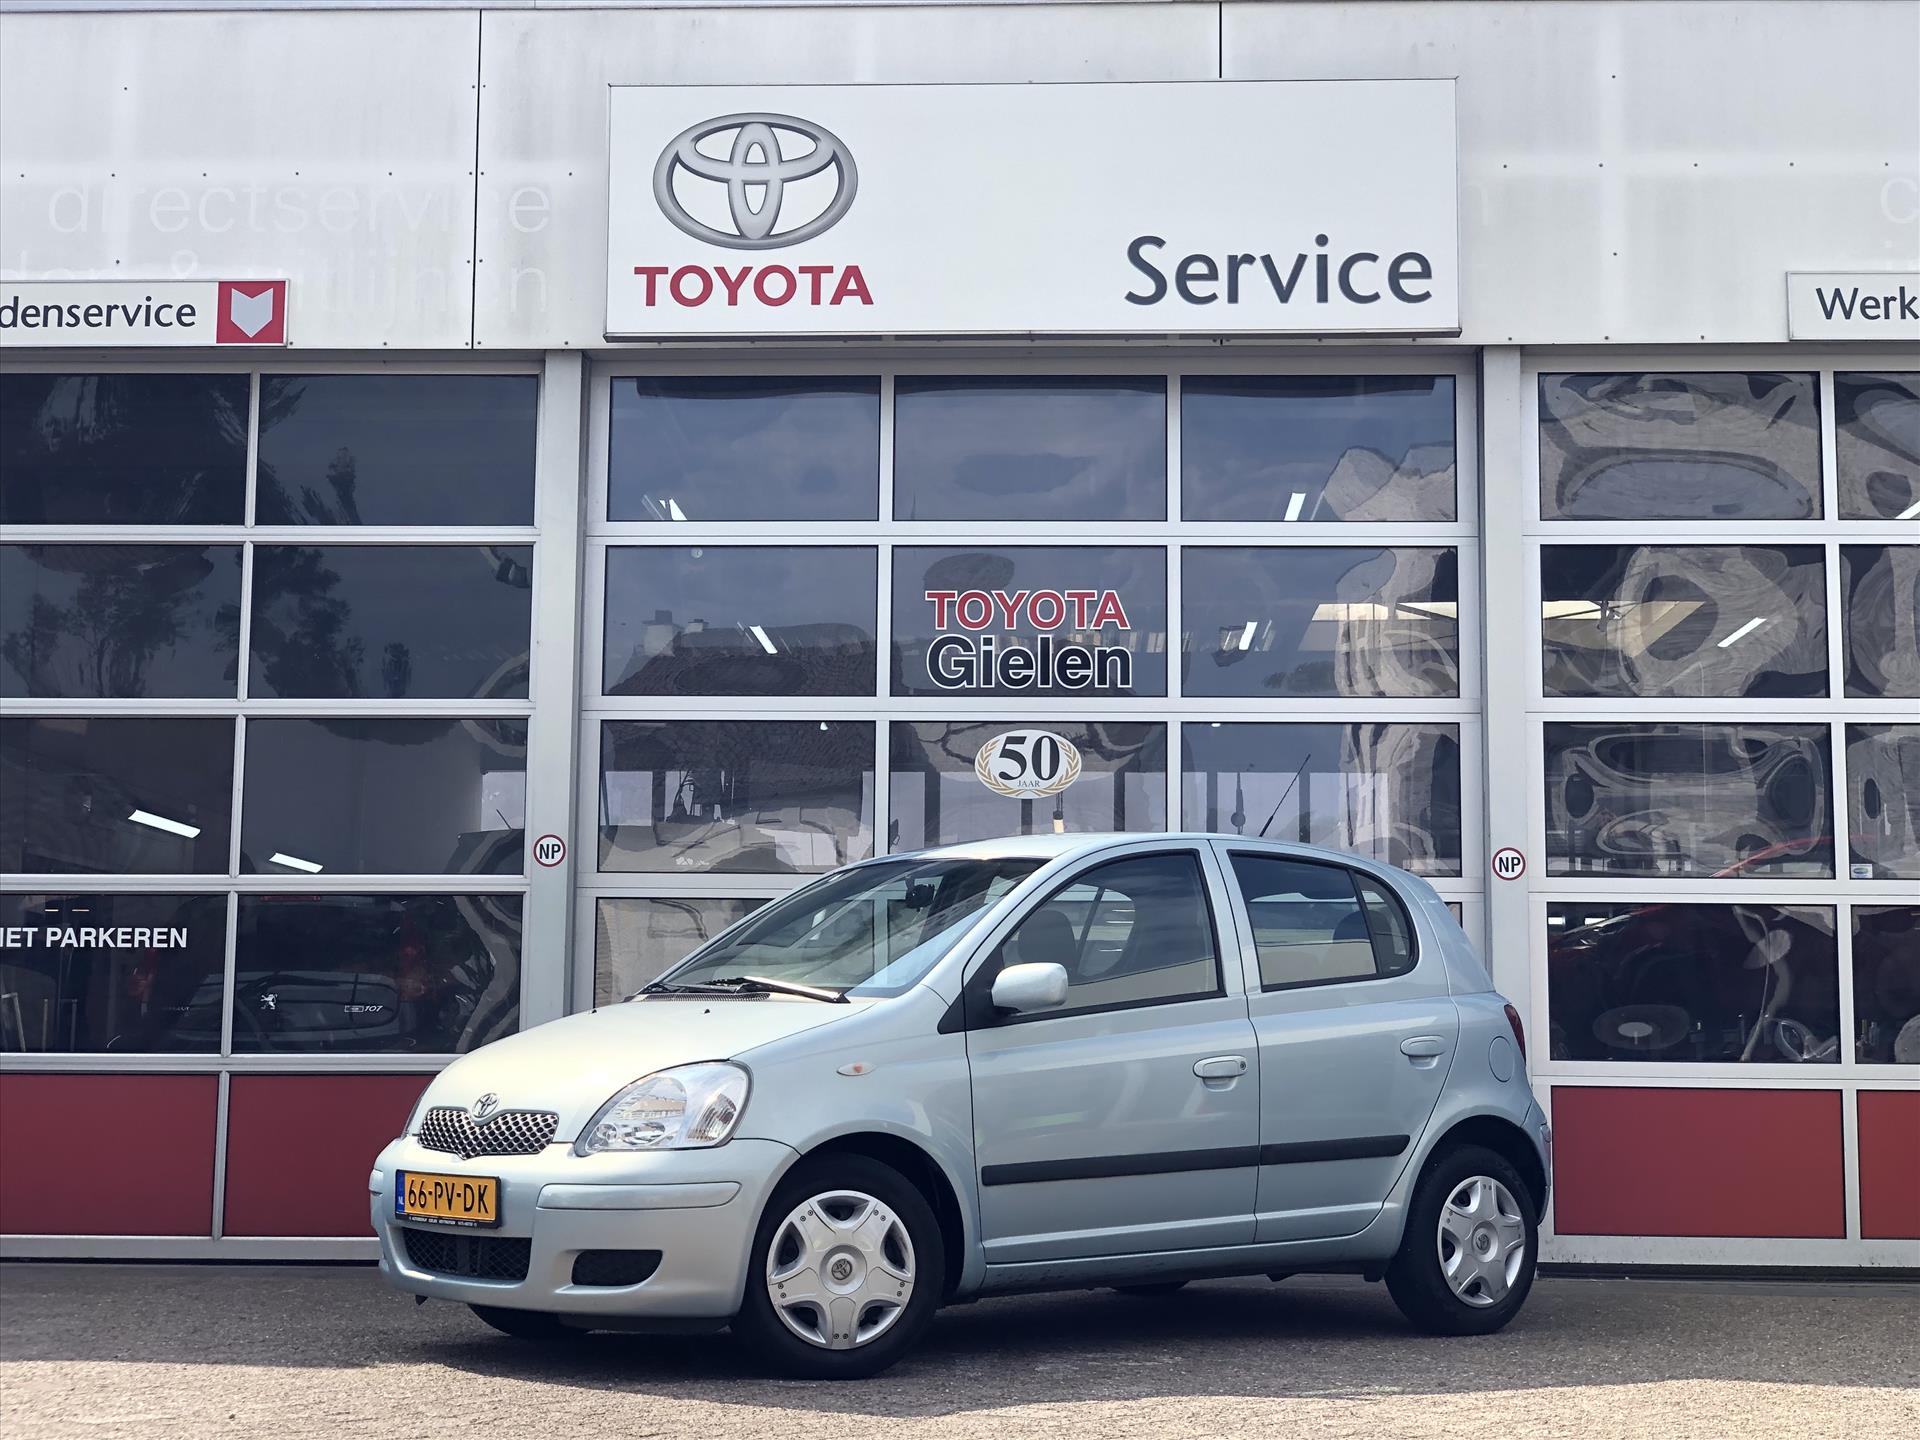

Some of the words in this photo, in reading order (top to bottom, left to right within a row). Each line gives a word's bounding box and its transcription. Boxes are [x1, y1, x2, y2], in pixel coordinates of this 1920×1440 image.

[634, 264, 874, 307] TOYOTA
[1124, 233, 1433, 306] Service
[0, 295, 196, 329] denservice
[1815, 286, 1920, 321] Werk
[925, 590, 1131, 630] TOYOTA
[926, 634, 1133, 689] Gielen
[998, 735, 1060, 781] 50
[1017, 780, 1041, 788] JAAR
[539, 843, 562, 860] NP
[1498, 856, 1521, 873] NP
[45, 927, 188, 949] PARKEREN
[408, 1179, 489, 1214] 66-PV-DK
